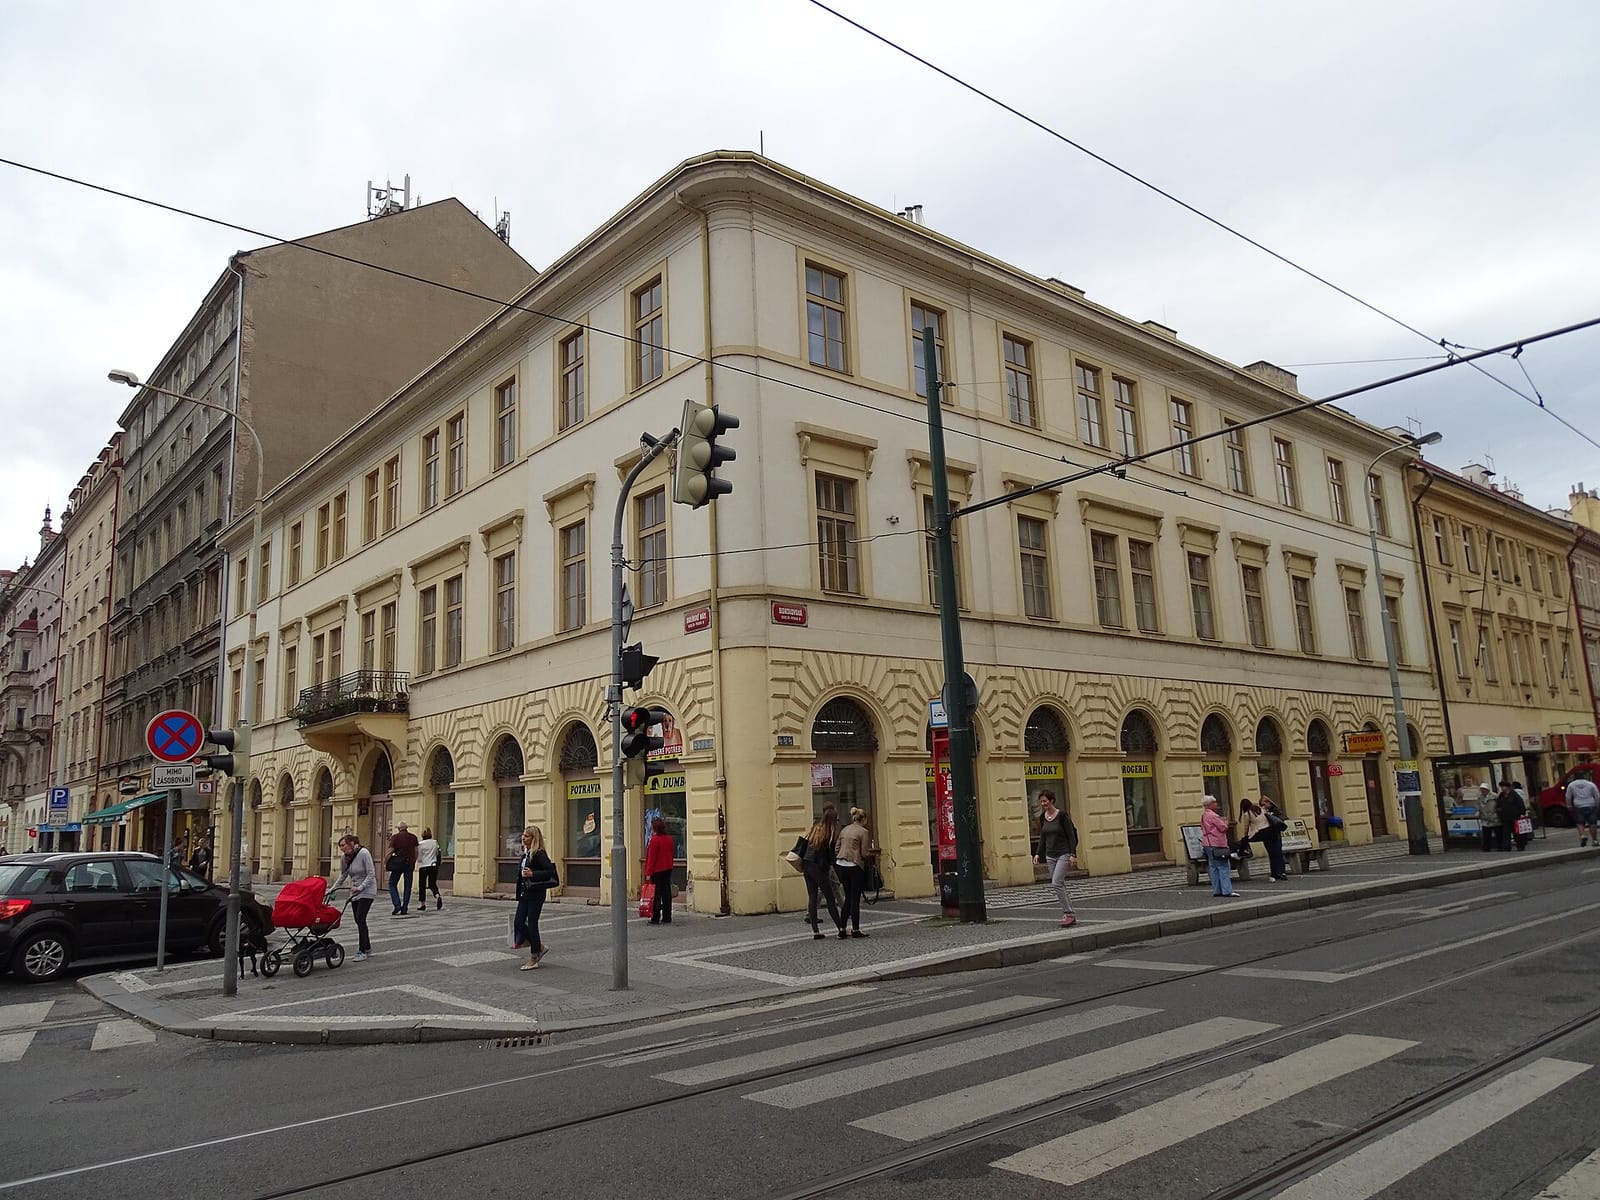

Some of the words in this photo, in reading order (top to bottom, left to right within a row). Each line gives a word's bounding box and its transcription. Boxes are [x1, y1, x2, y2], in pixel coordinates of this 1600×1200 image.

[166, 767, 183, 775] MIMO
[156, 774, 191, 785] ZÁSOBOVÁNÍ
[53, 789, 66, 803] P
